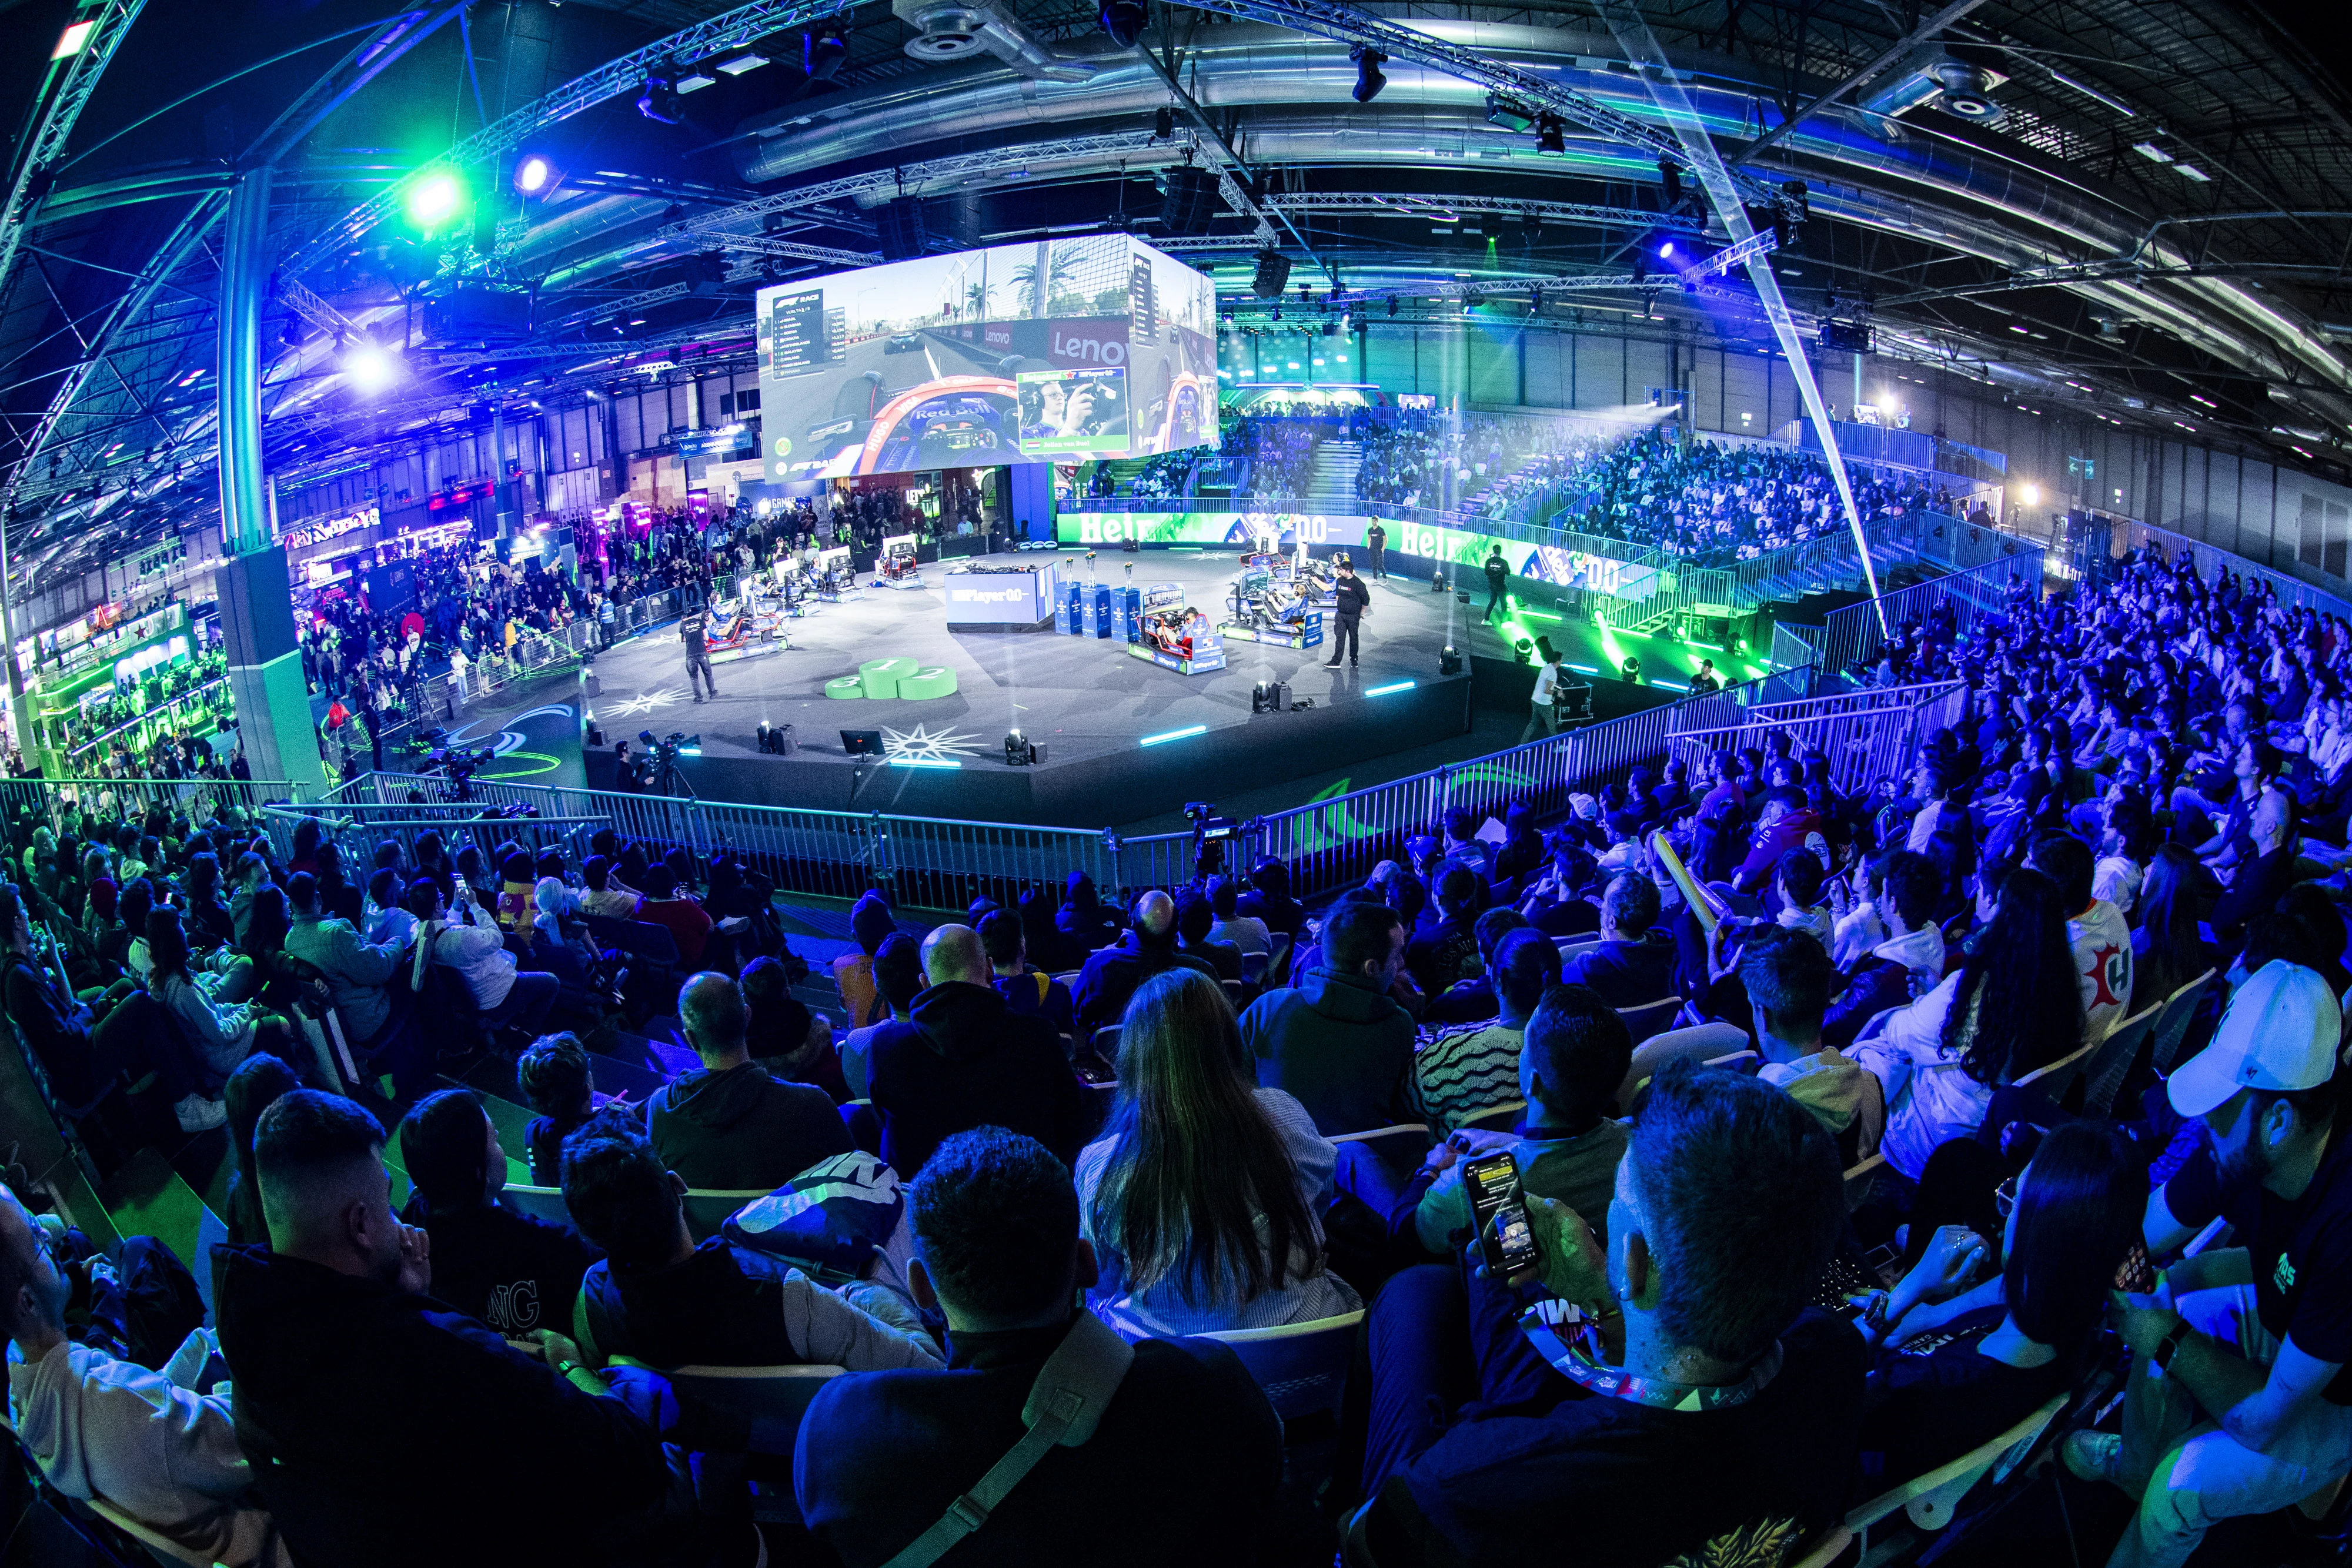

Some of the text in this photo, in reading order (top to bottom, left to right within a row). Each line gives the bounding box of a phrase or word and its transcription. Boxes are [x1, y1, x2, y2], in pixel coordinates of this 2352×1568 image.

[800, 294, 819, 303] RACE
[985, 329, 1010, 345] Lenovo
[895, 396, 921, 414] VISA
[916, 407, 950, 419] Red
[866, 421, 890, 452] HUGO
[952, 589, 1006, 604] Player
[871, 660, 900, 670] 1
[912, 668, 946, 679] 2
[832, 677, 861, 688] 3
